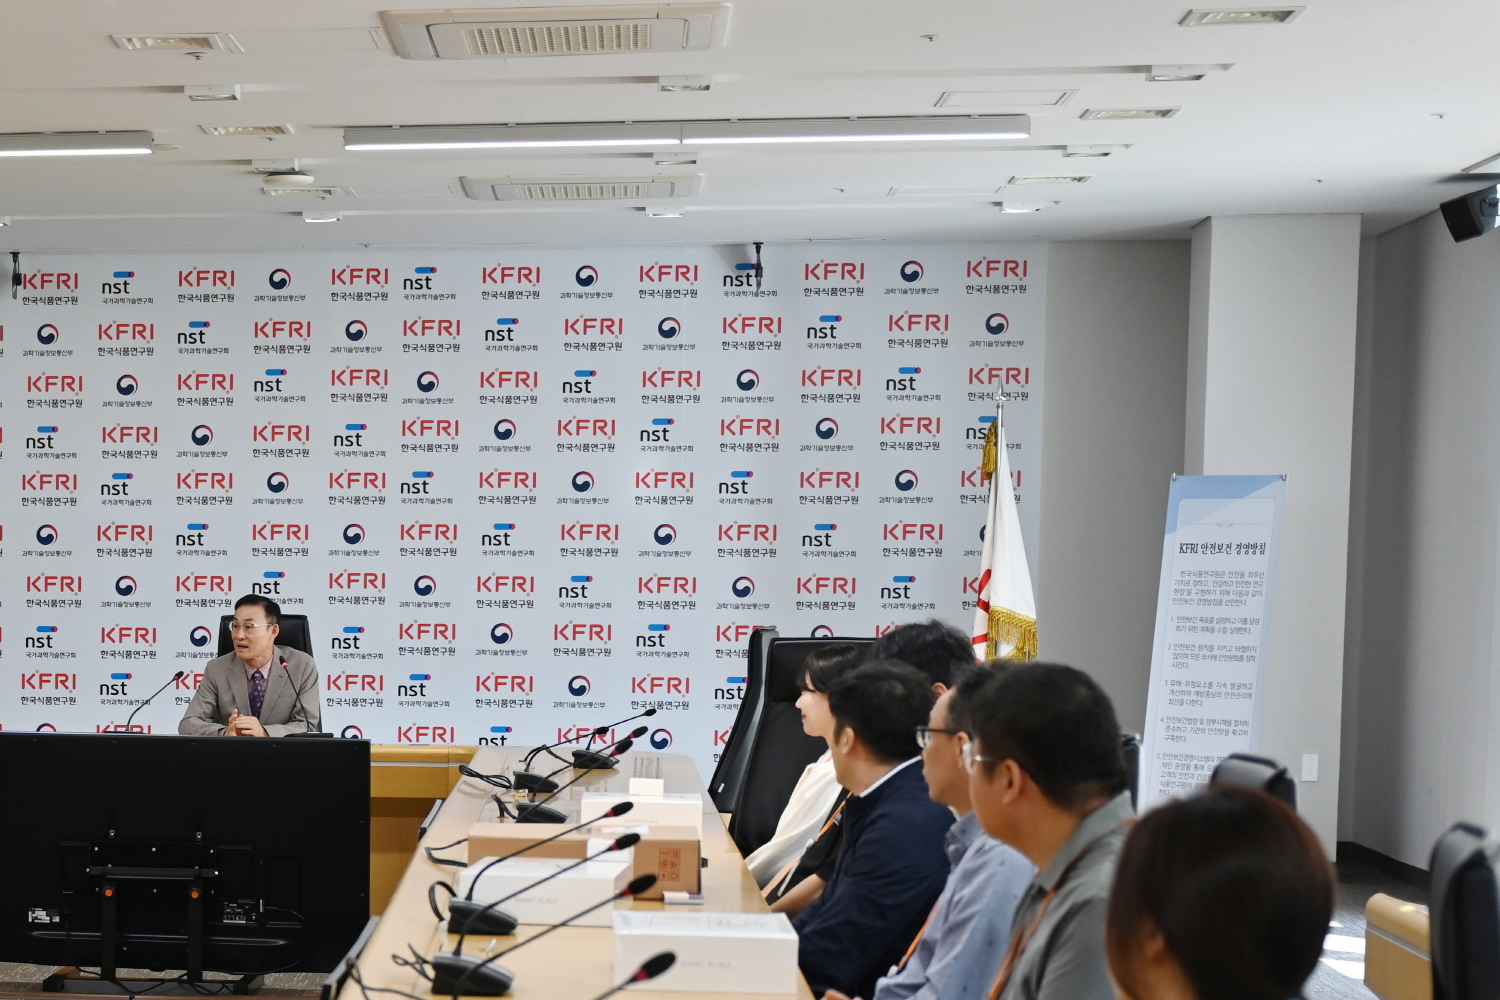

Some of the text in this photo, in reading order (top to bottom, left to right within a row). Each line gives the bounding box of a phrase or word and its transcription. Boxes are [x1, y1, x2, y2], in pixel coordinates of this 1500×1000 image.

[967, 261, 1027, 276] KFRI
[179, 271, 235, 286] KFRI
[404, 276, 432, 290] nst
[884, 287, 939, 295] 과학기술정보통신부
[965, 285, 1027, 294] 한국식품연구원
[177, 294, 235, 303] 한국식품연구원
[403, 293, 456, 301] 국가과학기술연구회
[723, 317, 782, 333] KFRI
[807, 325, 836, 339] nst
[721, 341, 782, 350] 한국식품연구원
[807, 342, 862, 350] 국가과학기술연구회
[480, 372, 538, 387] KFRI
[102, 400, 153, 408] 과학기술정보통신부
[479, 396, 538, 404] 한국식품연구원
[177, 473, 233, 488] KFRI
[176, 497, 233, 505] 한국식품연구원
[878, 496, 934, 504] 과학기술정보통신부
[561, 525, 619, 540] KFRI
[884, 524, 943, 539] KFRI
[803, 533, 831, 546] nst
[560, 548, 619, 556] 한국식품연구원
[882, 548, 943, 557] 한국식품연구원
[1179, 542, 1266, 555] KFRI 안전보건 경영방침
[803, 550, 857, 558] 국가과학기술연구회
[1177, 616, 1197, 624] 안전보건
[101, 628, 157, 642] KFRI
[26, 635, 53, 648] nst
[25, 651, 76, 659] 국가과학기술연구회
[100, 650, 157, 659] 한국식품연구원
[476, 676, 534, 691] KFRI
[475, 699, 533, 707] 한국식품연구원
